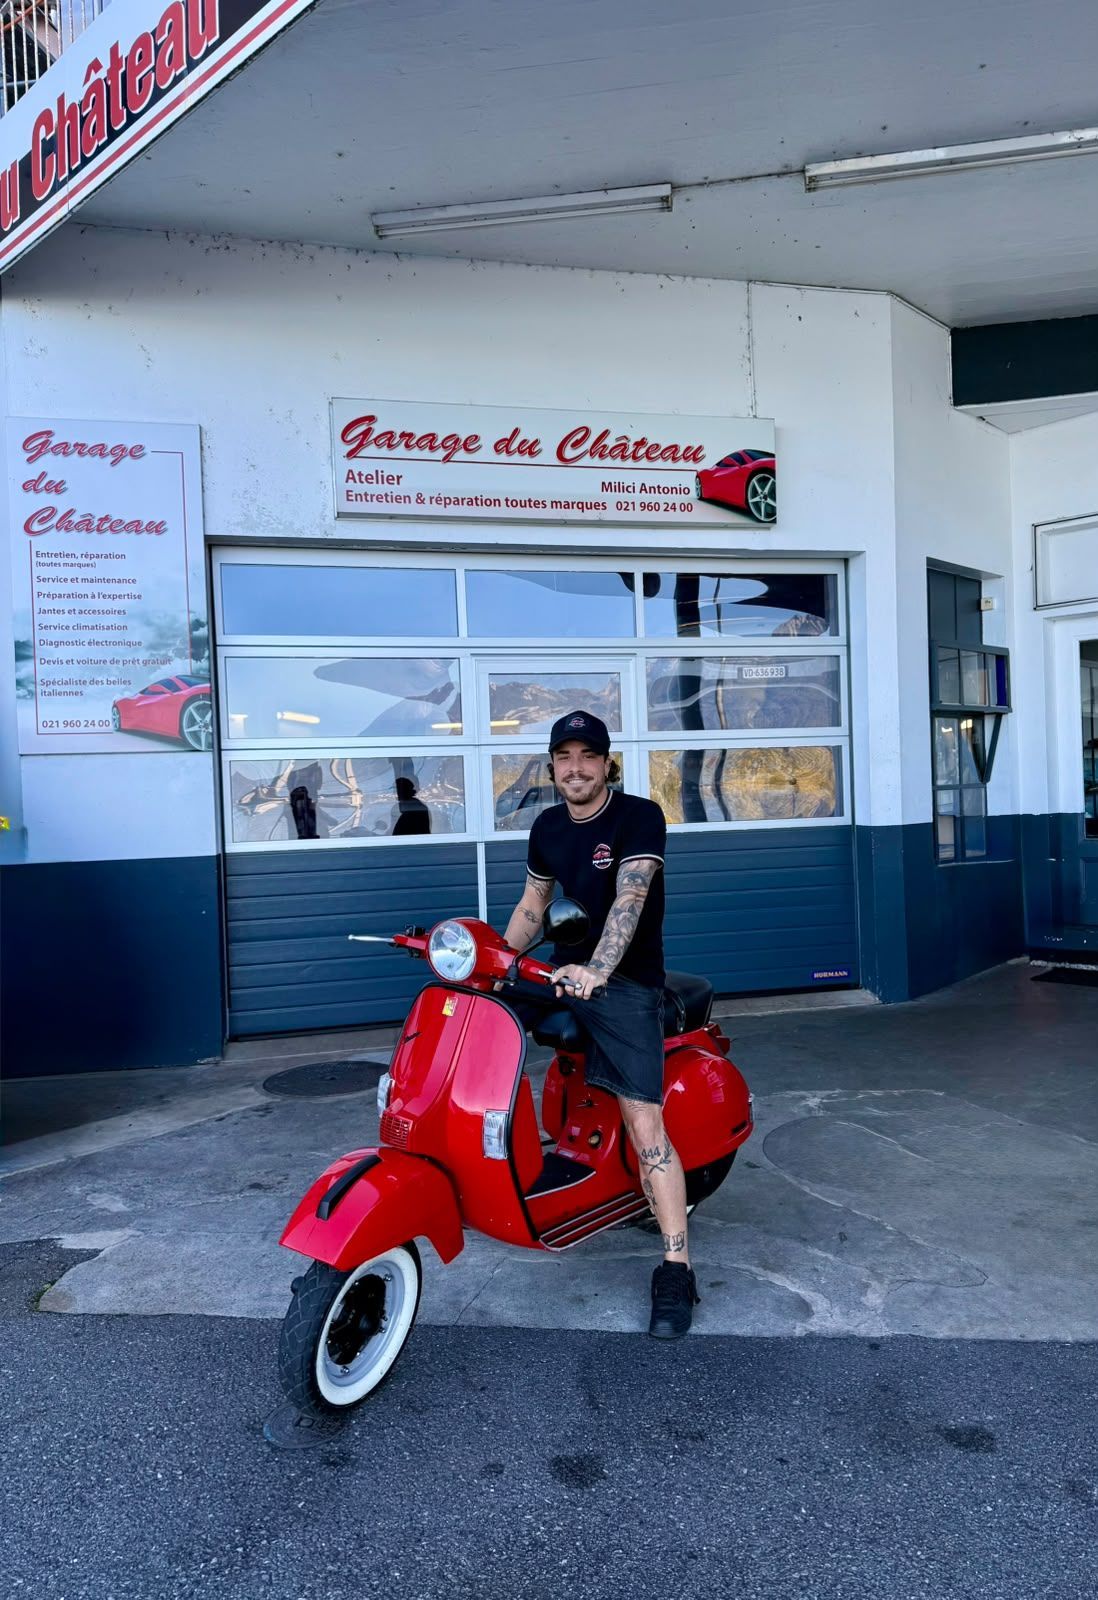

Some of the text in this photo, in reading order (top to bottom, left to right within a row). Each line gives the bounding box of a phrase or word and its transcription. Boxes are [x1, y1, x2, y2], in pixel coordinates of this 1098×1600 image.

[31, 0, 220, 201] Château
[340, 414, 706, 464] Garage du Château
[22, 430, 146, 467] Garage
[21, 471, 67, 495] du
[345, 469, 403, 486] Atelier
[601, 481, 691, 496] Milici Antonio
[345, 489, 607, 514] Entretien & réparation toutes marques
[615, 500, 693, 513] 021 960 24 00
[23, 505, 168, 536] Château
[35, 551, 126, 561] Entretien, réparation
[35, 560, 97, 569] (toutes marques)
[36, 575, 137, 585] Service et maintenance
[37, 591, 142, 602] Préparation à l'expertise
[37, 607, 127, 616] Jantes et accessoires
[38, 623, 128, 631] Service climatisation
[39, 638, 143, 649] Diagnostic électronique
[39, 657, 64, 665] Devis
[76, 657, 108, 665] voiture
[109, 657, 121, 665] de
[142, 657, 172, 667] gratuit
[40, 678, 132, 688] Spécialiste des belles
[40, 689, 84, 697] italiennes
[42, 719, 110, 728] 021 960 24 00
